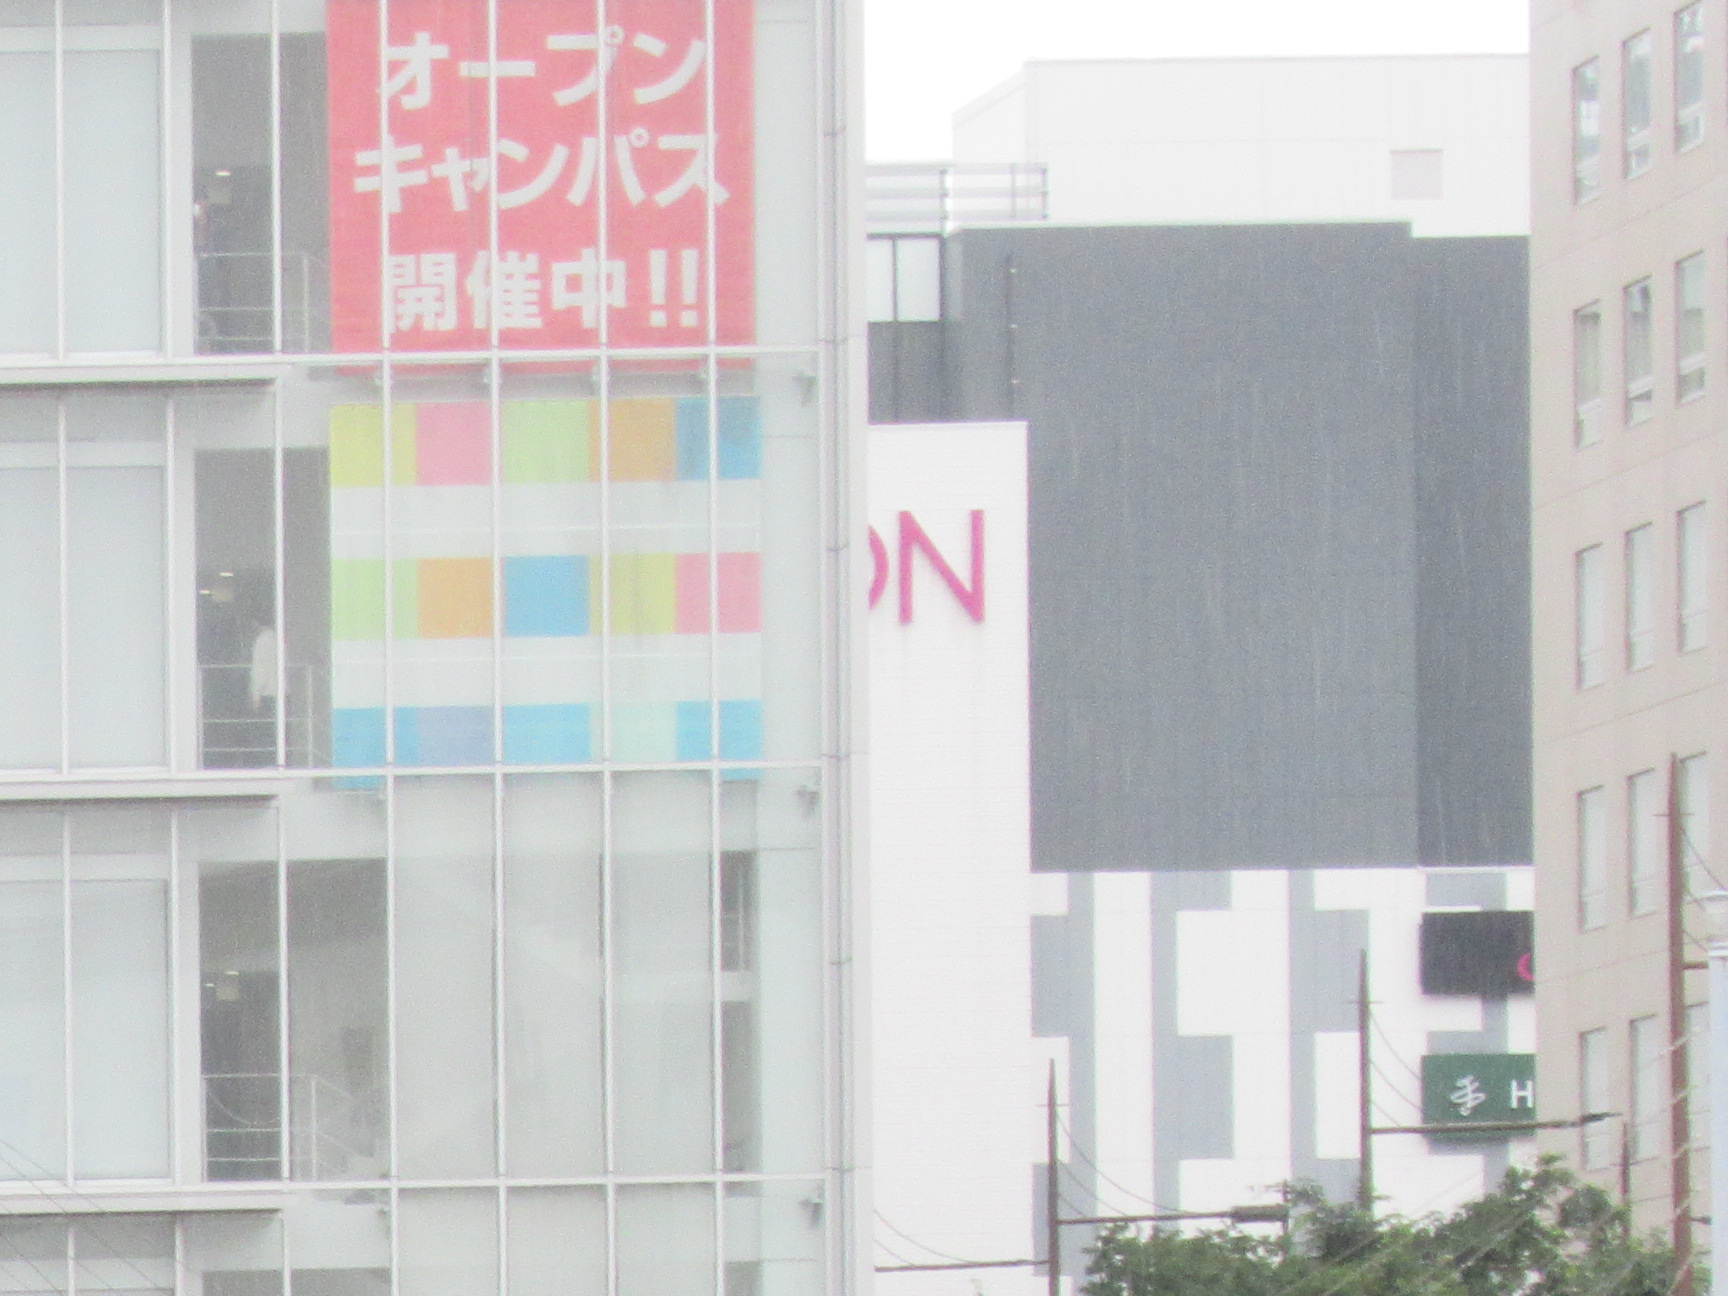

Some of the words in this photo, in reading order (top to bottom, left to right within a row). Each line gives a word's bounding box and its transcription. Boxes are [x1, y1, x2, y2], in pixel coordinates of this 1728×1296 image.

[375, 24, 708, 109] オープン
[353, 128, 730, 213] キャンパス
[868, 509, 985, 626] N
